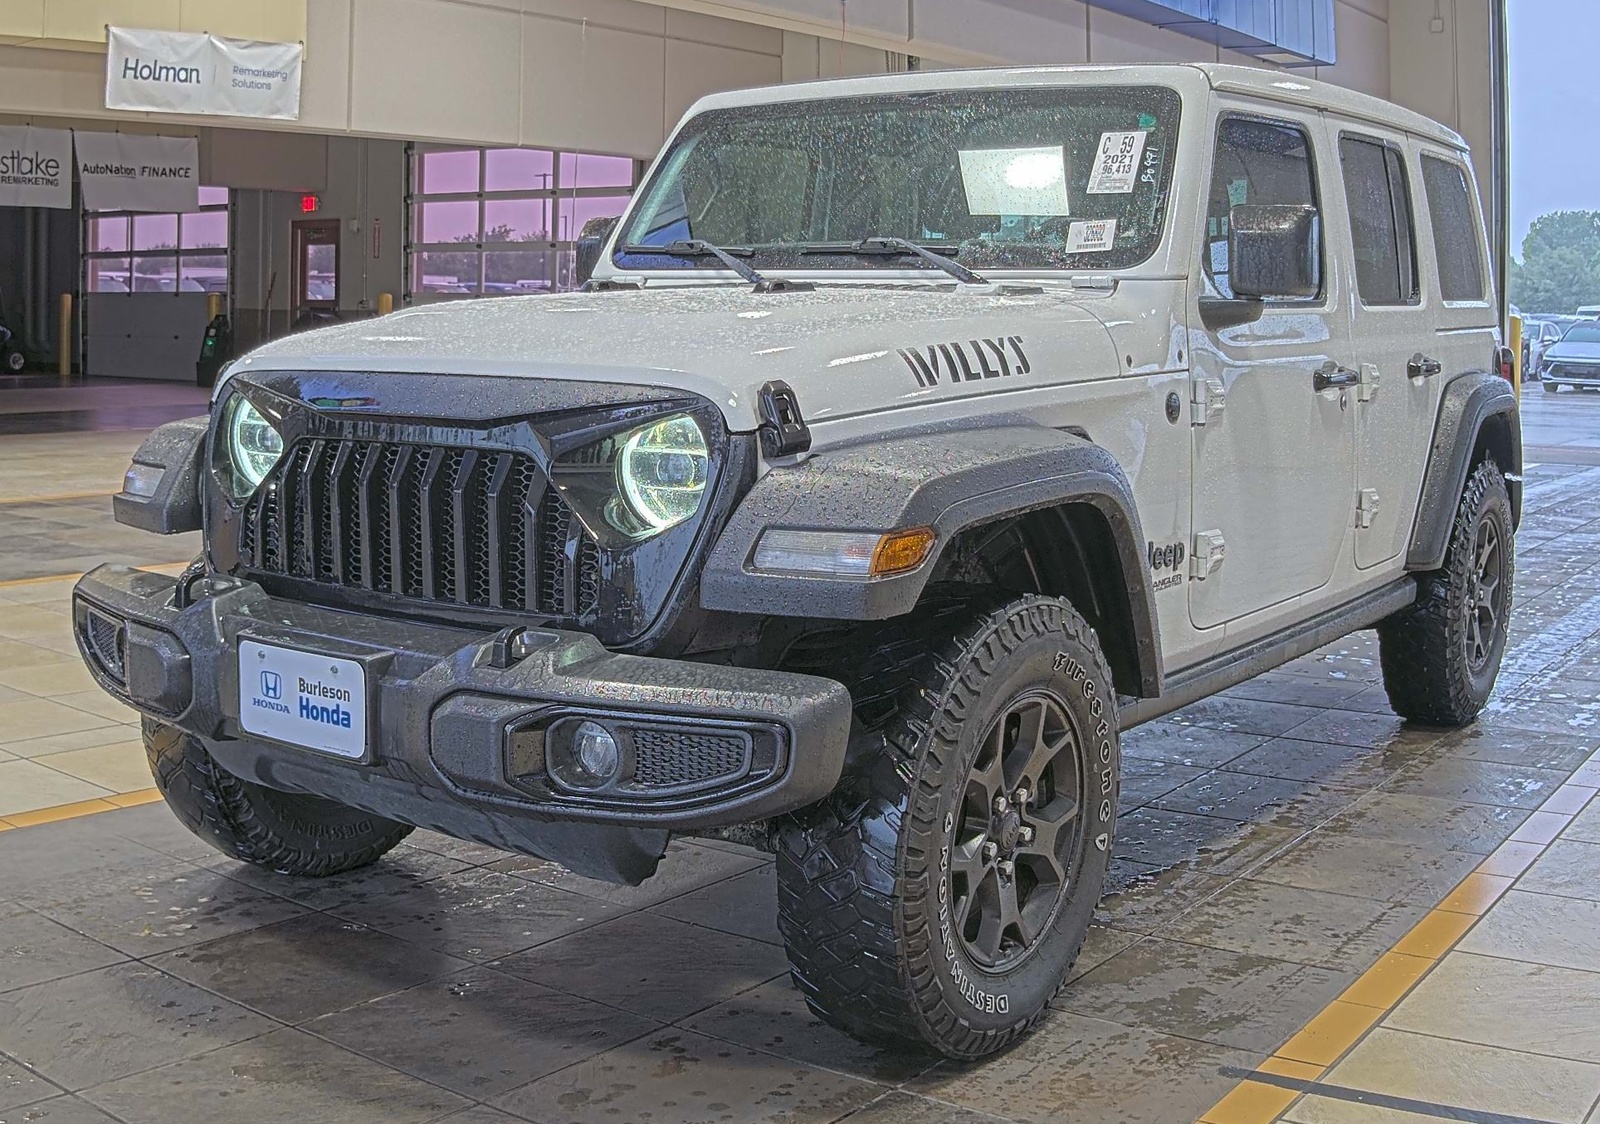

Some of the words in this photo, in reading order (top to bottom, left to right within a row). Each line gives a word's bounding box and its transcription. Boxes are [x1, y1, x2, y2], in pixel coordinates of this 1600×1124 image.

[122, 57, 201, 84] Holman
[232, 65, 288, 82] Remarketing
[231, 78, 272, 91] Solutions
[1102, 136, 1111, 154] C
[1119, 135, 1135, 154] 59
[82, 163, 136, 176] AutoNation
[141, 166, 191, 178] FINANCE
[1101, 164, 1132, 175] 96,413
[1103, 154, 1134, 164] 2021
[896, 335, 1031, 388] WILLYS
[1148, 540, 1185, 571] Jeep
[298, 677, 351, 703] Burleson
[252, 697, 291, 714] HONDA
[299, 695, 352, 729] Honda
[1052, 651, 1113, 823] Firestone
[938, 846, 1009, 1014] DESTINATION
